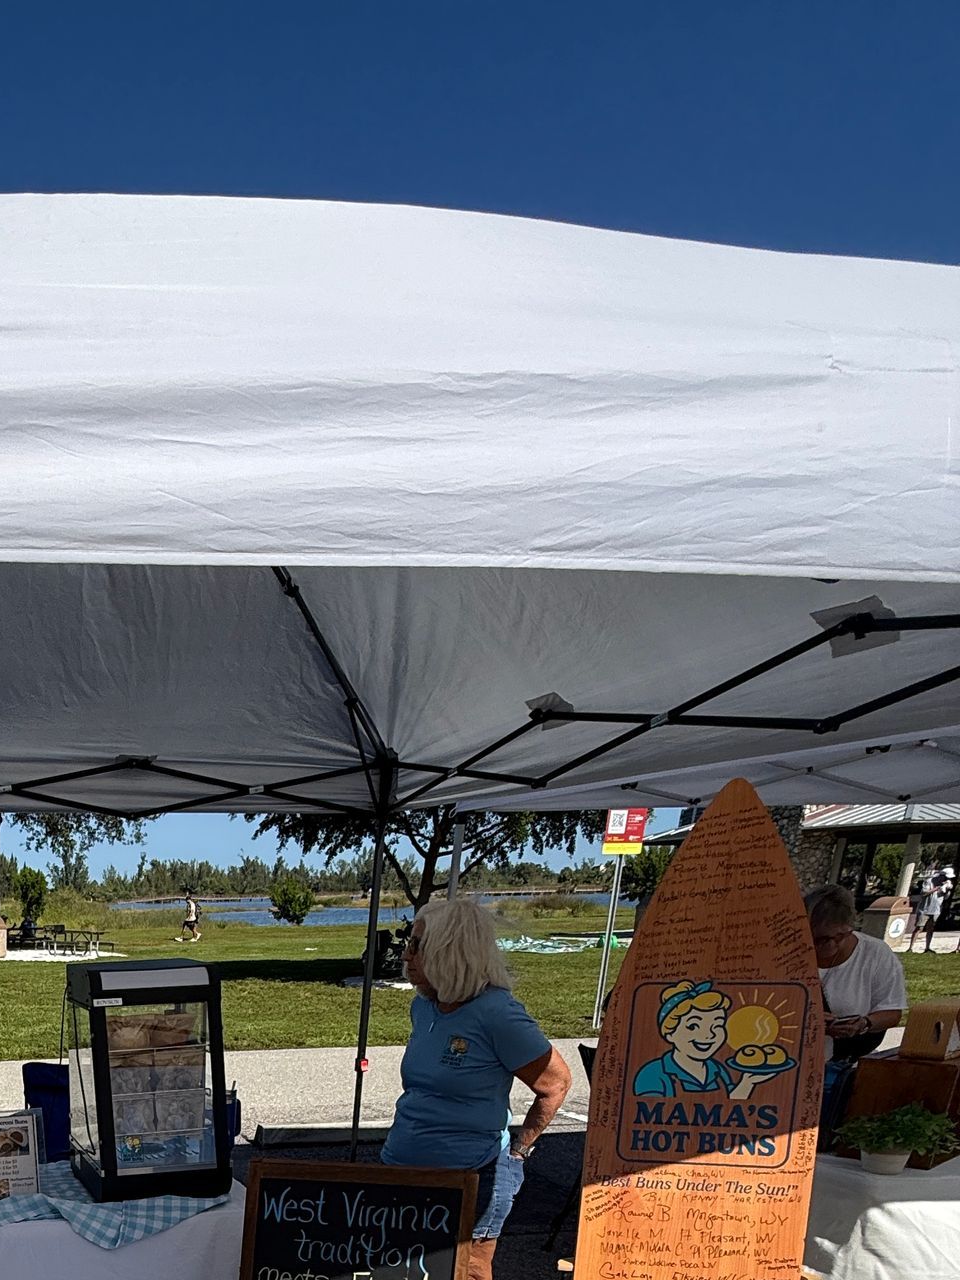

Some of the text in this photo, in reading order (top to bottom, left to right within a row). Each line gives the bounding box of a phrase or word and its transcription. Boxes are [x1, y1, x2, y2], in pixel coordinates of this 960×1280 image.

[633, 1101, 778, 1130] MAMA'S
[630, 1129, 776, 1157] HOT BUNS
[635, 1176, 672, 1190] Buns
[675, 1178, 721, 1192] Under
[725, 1180, 753, 1194] The
[263, 1187, 451, 1252] West Virginia
[294, 1230, 428, 1273] tradition
